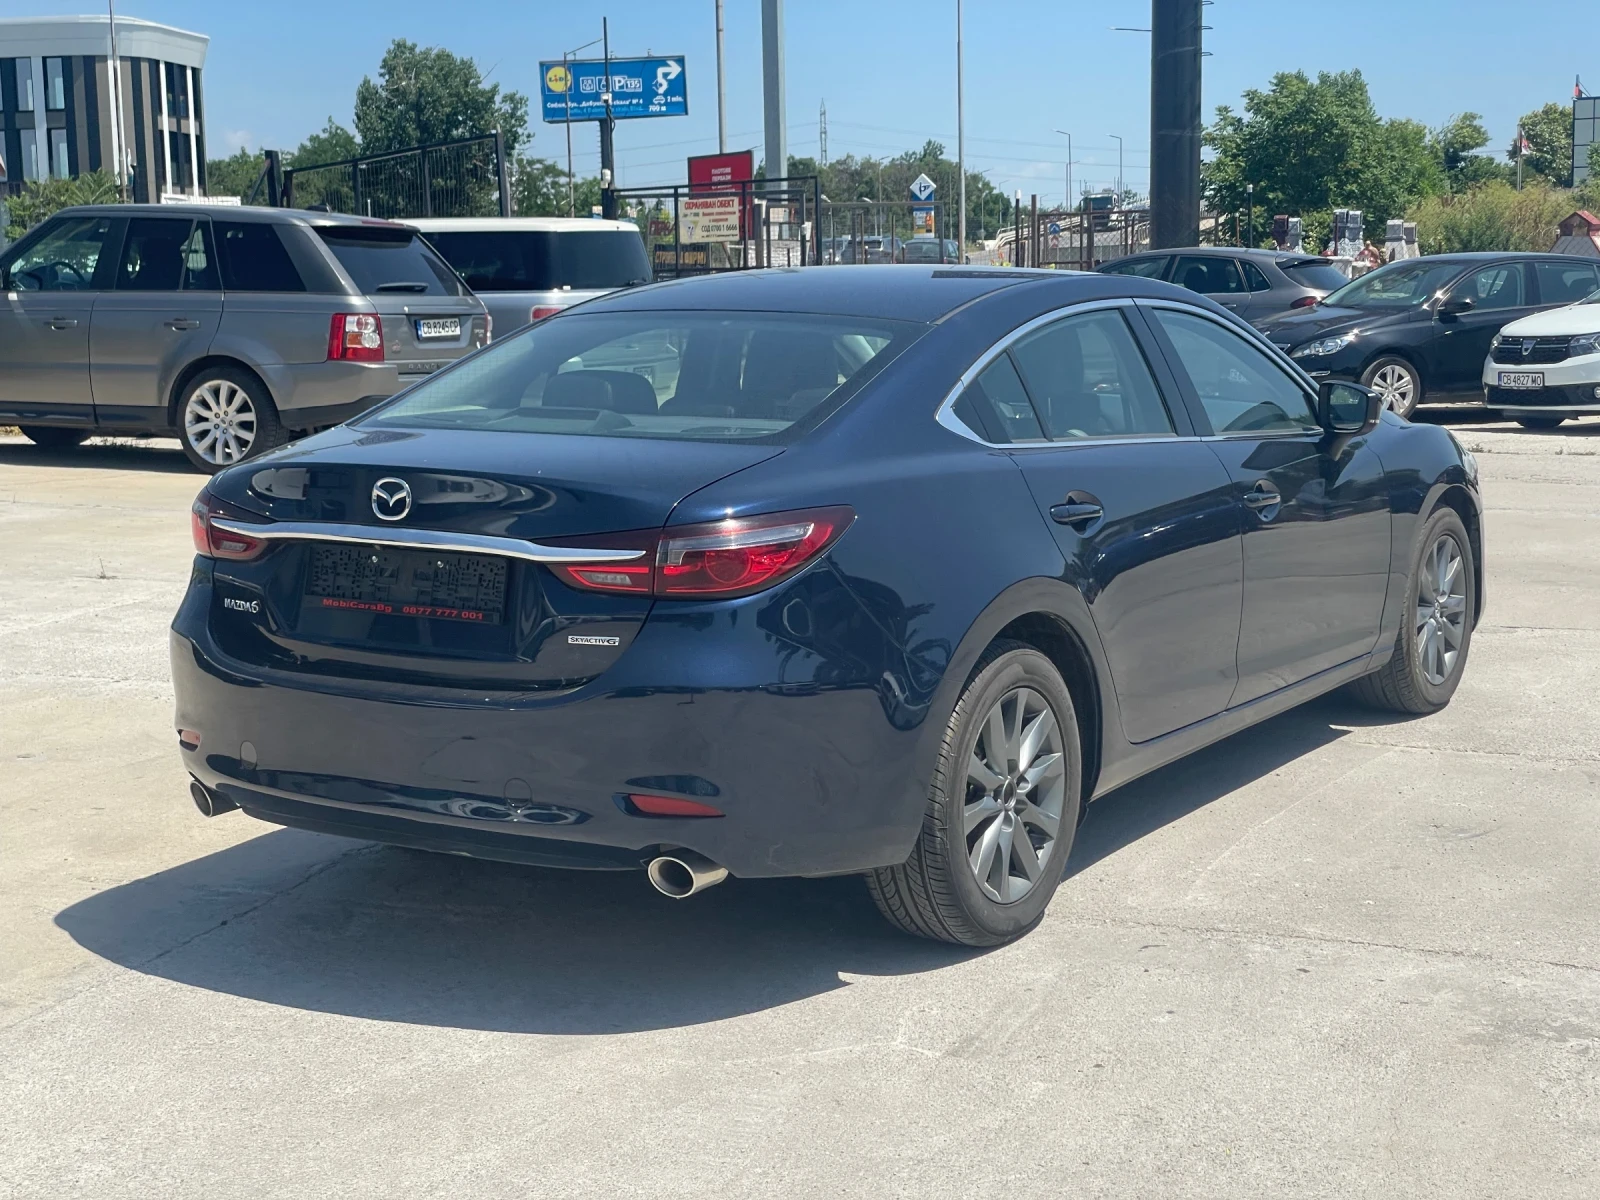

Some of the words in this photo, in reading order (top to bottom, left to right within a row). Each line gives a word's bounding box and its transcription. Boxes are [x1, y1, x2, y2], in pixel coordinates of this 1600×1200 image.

[627, 80, 640, 88] 135
[717, 199, 734, 208] ОБЕКТ
[701, 225, 710, 233] СОД
[726, 223, 738, 231] 6666
[422, 322, 432, 335] CB
[432, 321, 450, 334] 8245
[1503, 374, 1511, 385] CB
[1512, 374, 1530, 386] 4827
[1531, 375, 1541, 385] MO
[322, 599, 393, 613] MobiCarsBg
[402, 606, 431, 615] 0877
[436, 608, 458, 618] 777
[461, 610, 484, 620] 001
